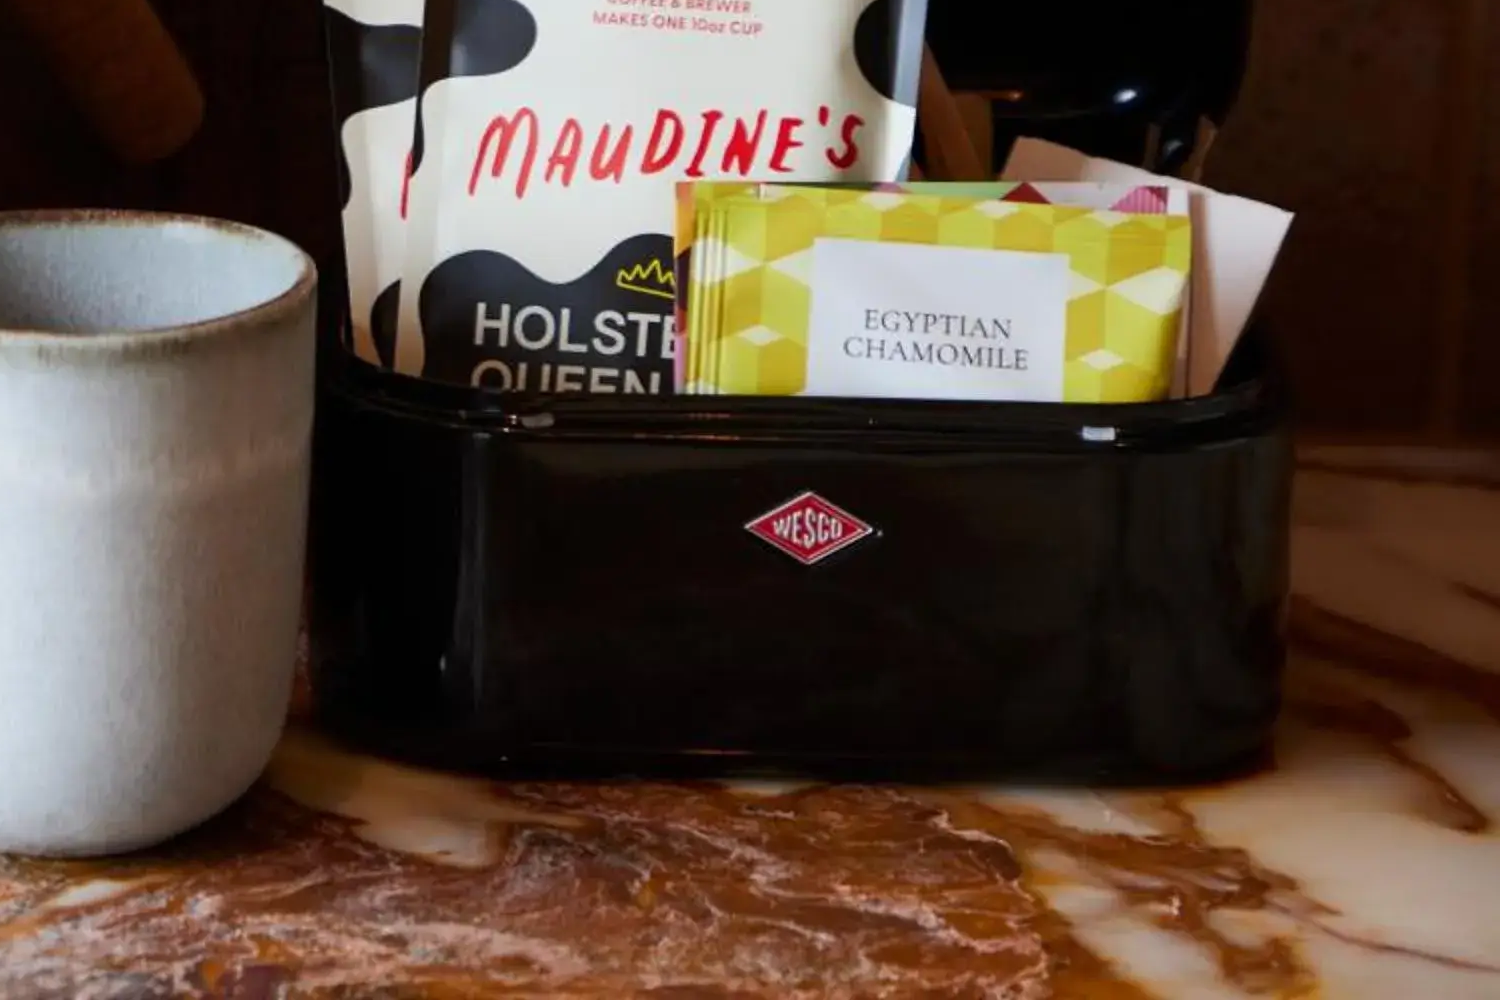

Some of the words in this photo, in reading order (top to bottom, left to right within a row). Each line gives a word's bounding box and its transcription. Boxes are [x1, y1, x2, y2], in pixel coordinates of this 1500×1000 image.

[592, 10, 649, 28] MAKES
[652, 15, 688, 31] ONE
[729, 20, 763, 36] CUP
[468, 105, 865, 200] MAUDINE'S
[864, 308, 1013, 340] EGYPTIAN
[842, 335, 1030, 371] CHAMOMILE
[773, 507, 843, 549] WESCO
